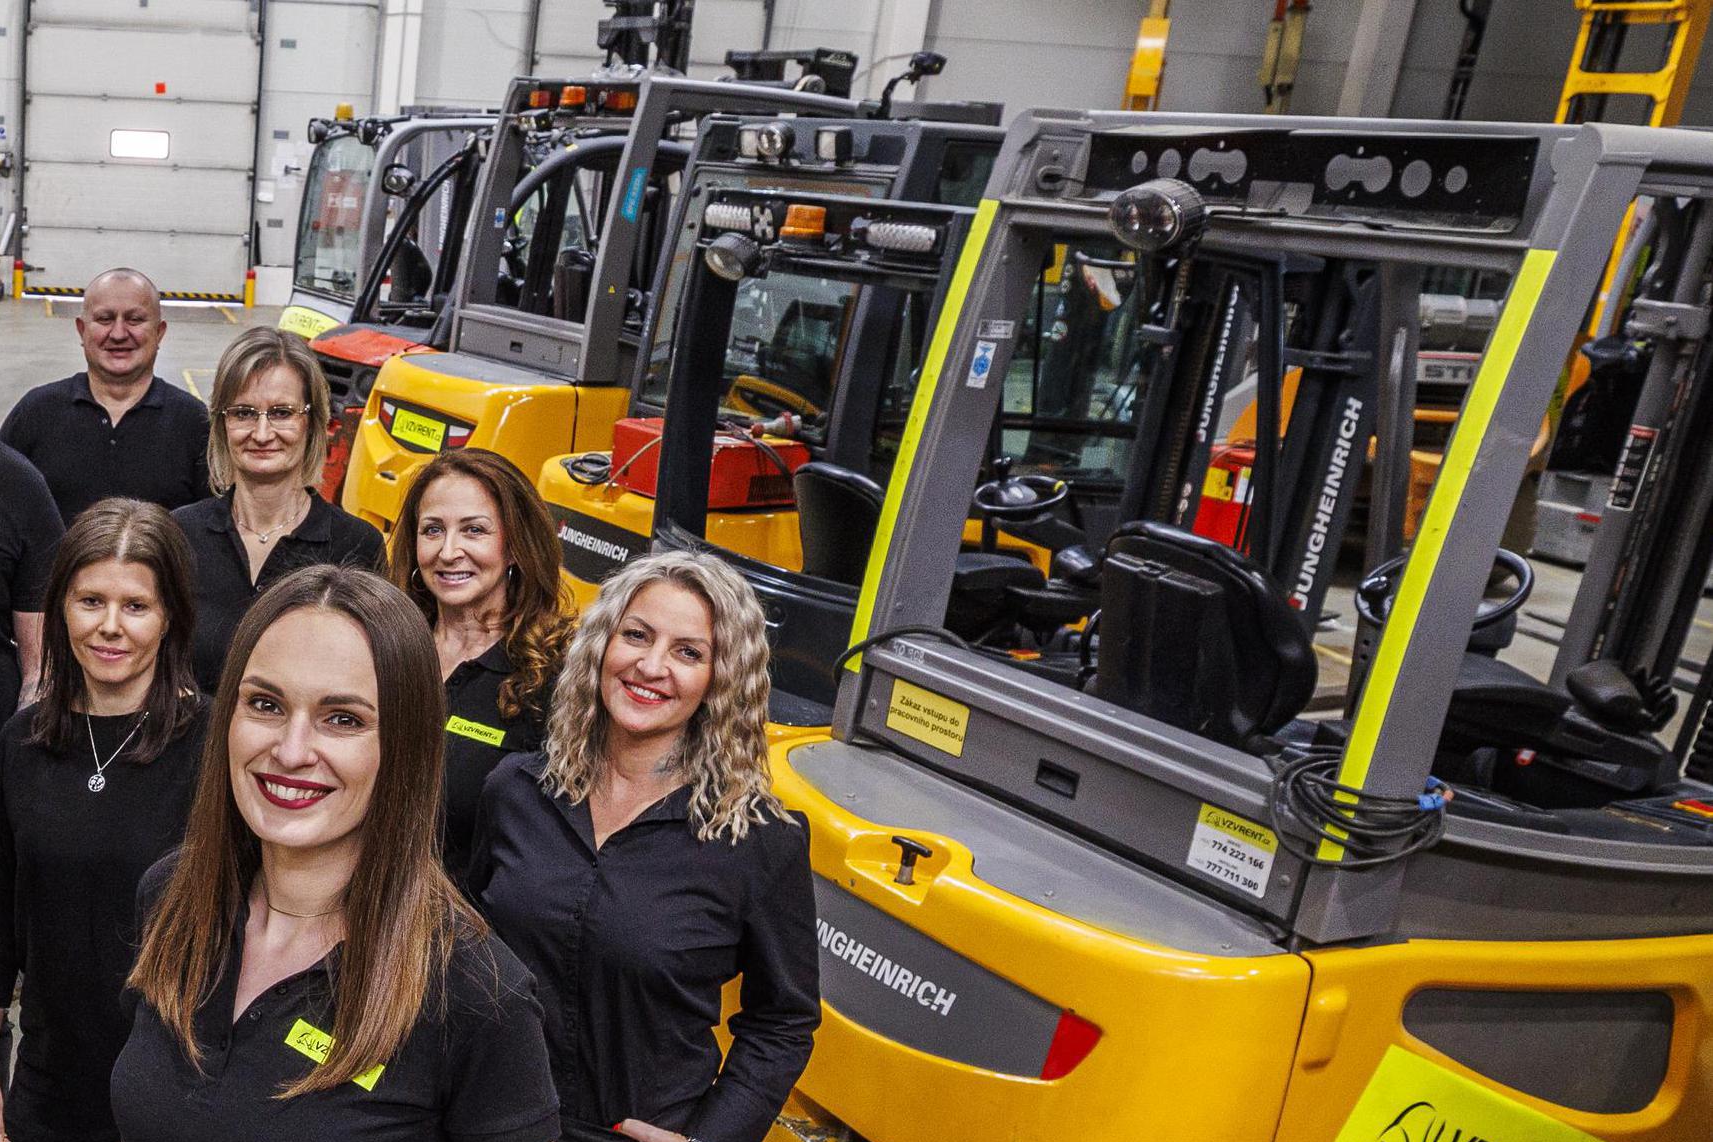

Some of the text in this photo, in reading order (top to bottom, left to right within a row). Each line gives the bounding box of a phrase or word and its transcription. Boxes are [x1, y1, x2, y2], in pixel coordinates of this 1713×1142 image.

[1288, 396, 1364, 612] JUNGHEINRICH
[557, 519, 629, 562] JUNGHEINRICH
[922, 707, 948, 722] vstupu
[949, 715, 960, 728] do
[930, 723, 964, 743] prostoru
[1222, 817, 1271, 846] VZVRENT.cz
[1212, 839, 1228, 854] 774
[1229, 848, 1246, 862] 222
[1206, 861, 1223, 874] 777
[1224, 868, 1241, 883] 711
[1241, 877, 1259, 891] 300
[815, 917, 957, 1017] NGHEINRICH
